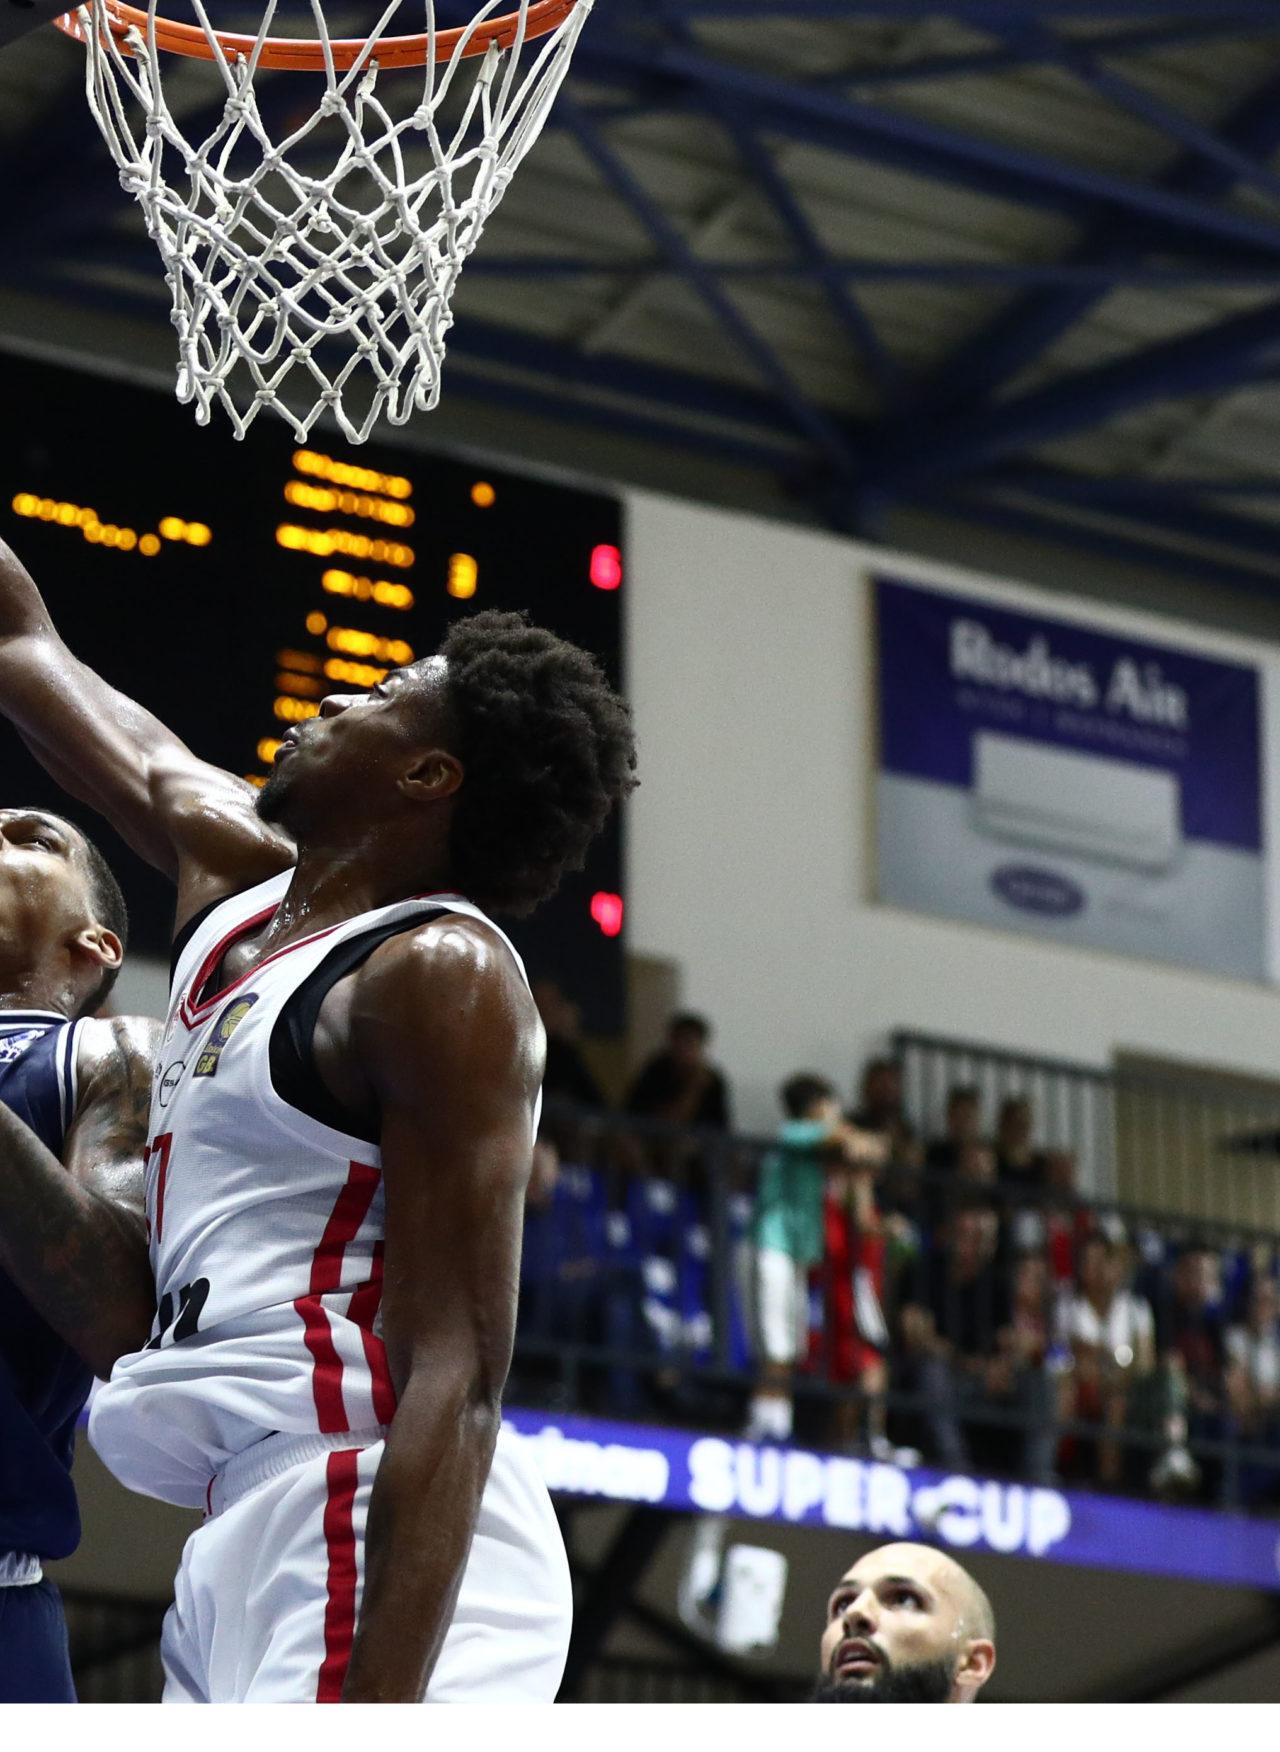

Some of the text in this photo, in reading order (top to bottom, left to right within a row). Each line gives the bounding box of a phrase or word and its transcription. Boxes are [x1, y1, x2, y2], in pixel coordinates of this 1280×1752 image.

[949, 617, 1098, 708] Rodos
[1106, 656, 1189, 731] Air
[689, 1437, 910, 1537] SUPER
[936, 1475, 1071, 1557] CUP
